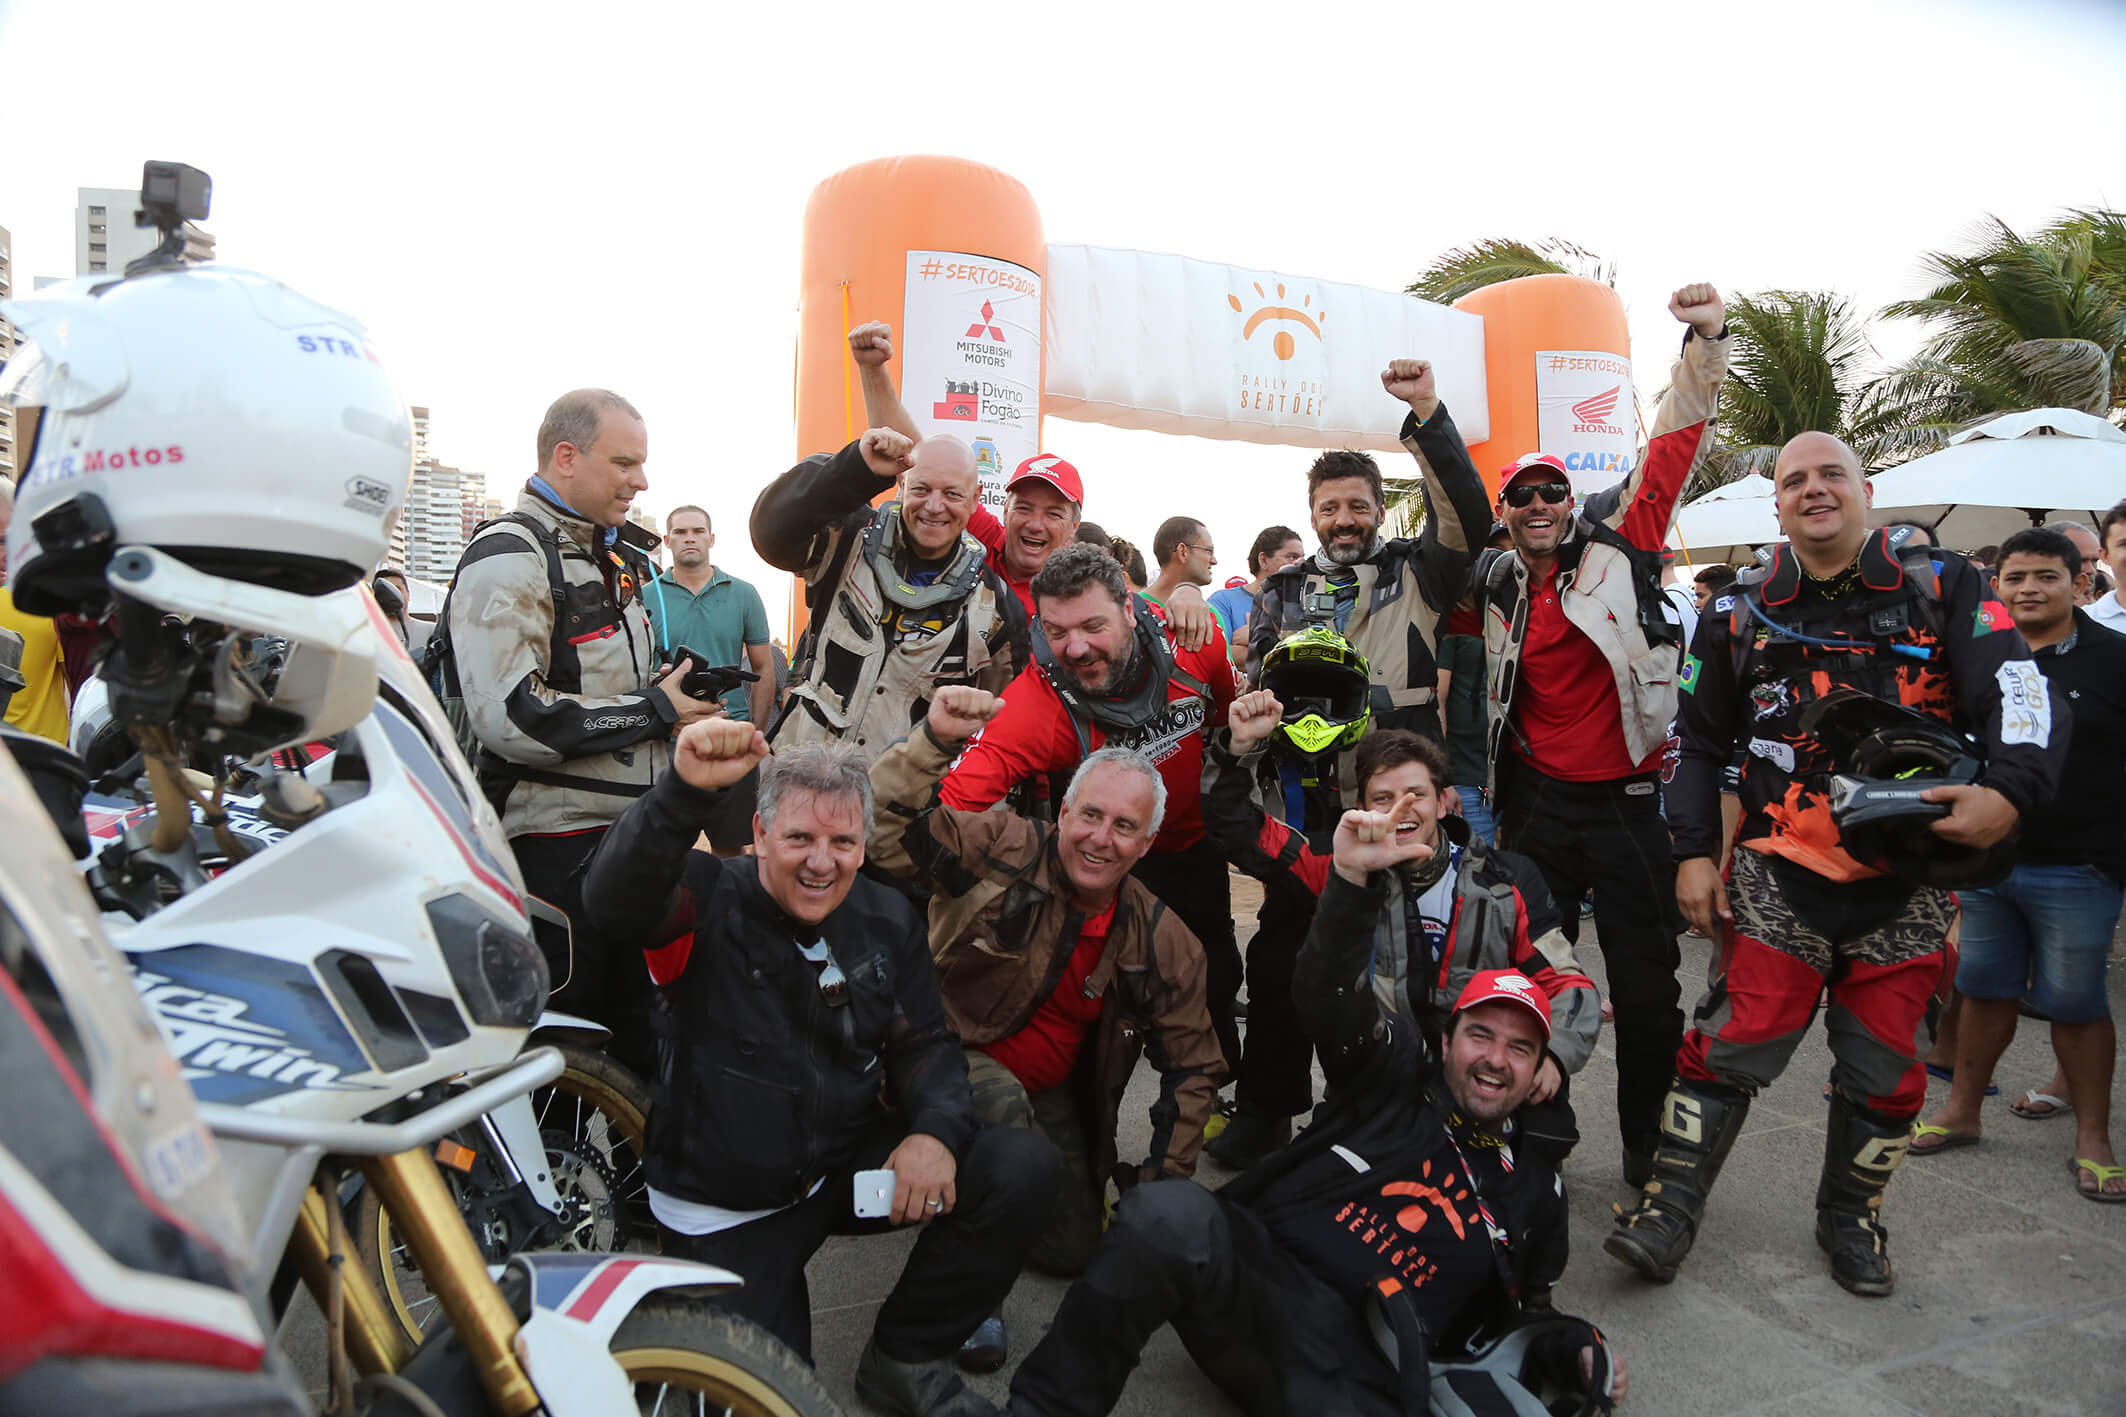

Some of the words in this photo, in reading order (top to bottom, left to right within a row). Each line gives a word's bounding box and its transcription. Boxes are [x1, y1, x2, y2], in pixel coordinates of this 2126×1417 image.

[919, 257, 1037, 297] #SERTOES2018
[297, 335, 361, 359] STR
[956, 341, 1012, 359] MITSUBISHI
[964, 353, 1006, 368] MOTORS
[982, 381, 1023, 403] Divino
[1242, 374, 1288, 392] RALLY
[982, 399, 1021, 420] Fogão
[1573, 424, 1624, 436] HONDA
[83, 444, 184, 473] Motos
[1565, 452, 1630, 473] CAIXA
